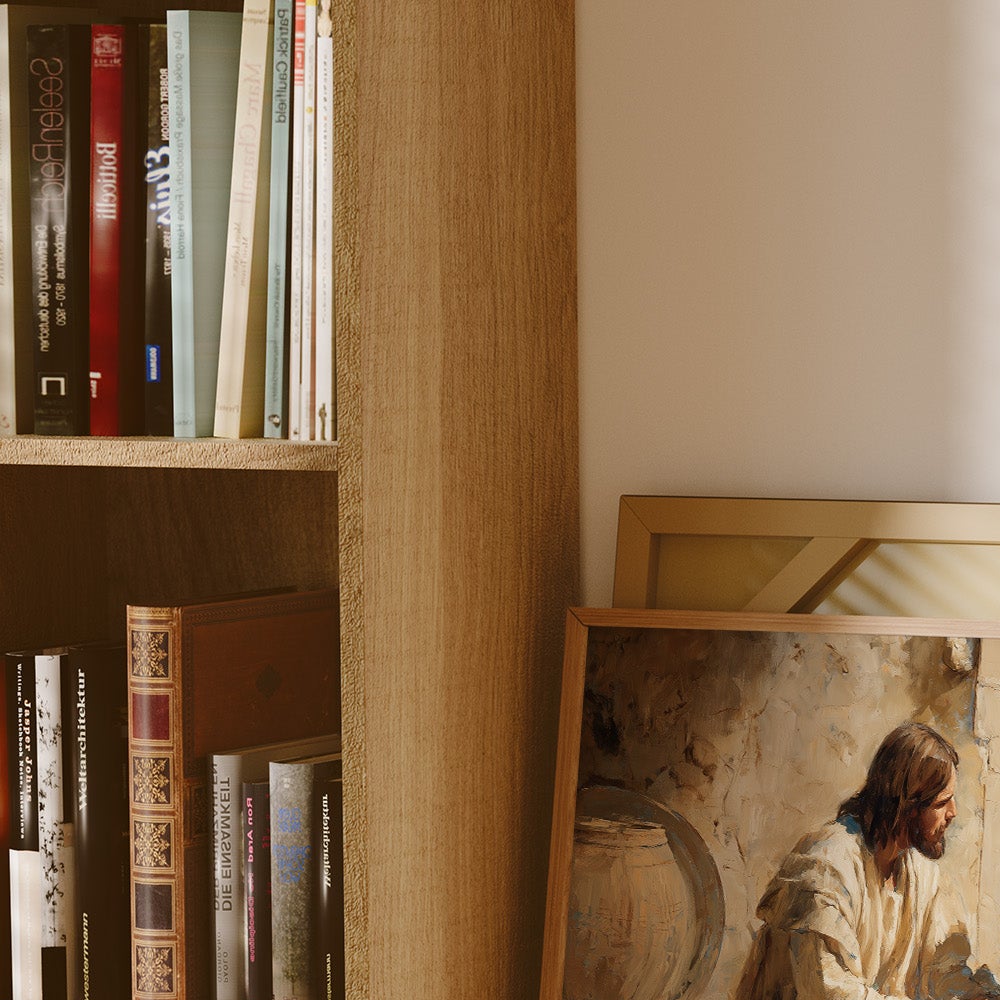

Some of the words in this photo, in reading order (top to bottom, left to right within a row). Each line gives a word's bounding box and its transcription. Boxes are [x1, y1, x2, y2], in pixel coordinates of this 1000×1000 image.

[24, 699, 32, 752] Jasper
[77, 668, 88, 812] Weltarchitektur
[25, 756, 33, 803] Johns
